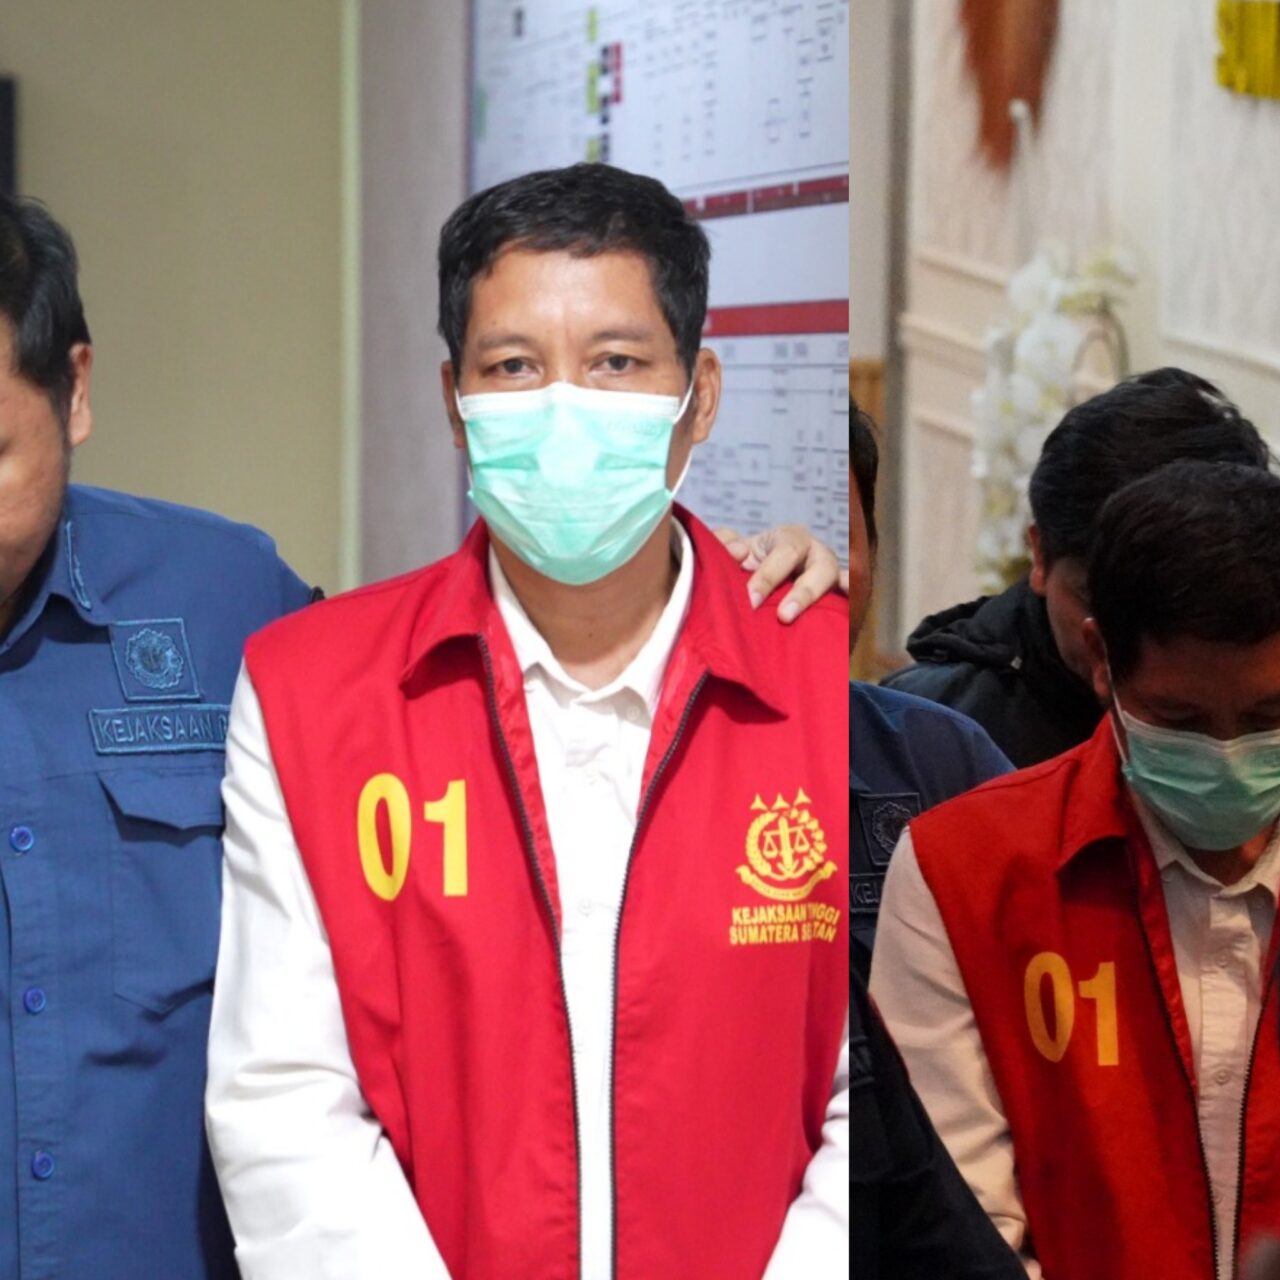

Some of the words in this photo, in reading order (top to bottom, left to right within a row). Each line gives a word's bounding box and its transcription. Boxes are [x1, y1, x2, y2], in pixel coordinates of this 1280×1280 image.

[97, 713, 214, 742] KEJAKSAAN
[357, 772, 468, 901] 01
[731, 903, 807, 926] KEJAKSAAN
[728, 923, 799, 945] SUMATERA
[1023, 951, 1119, 1066] 01
